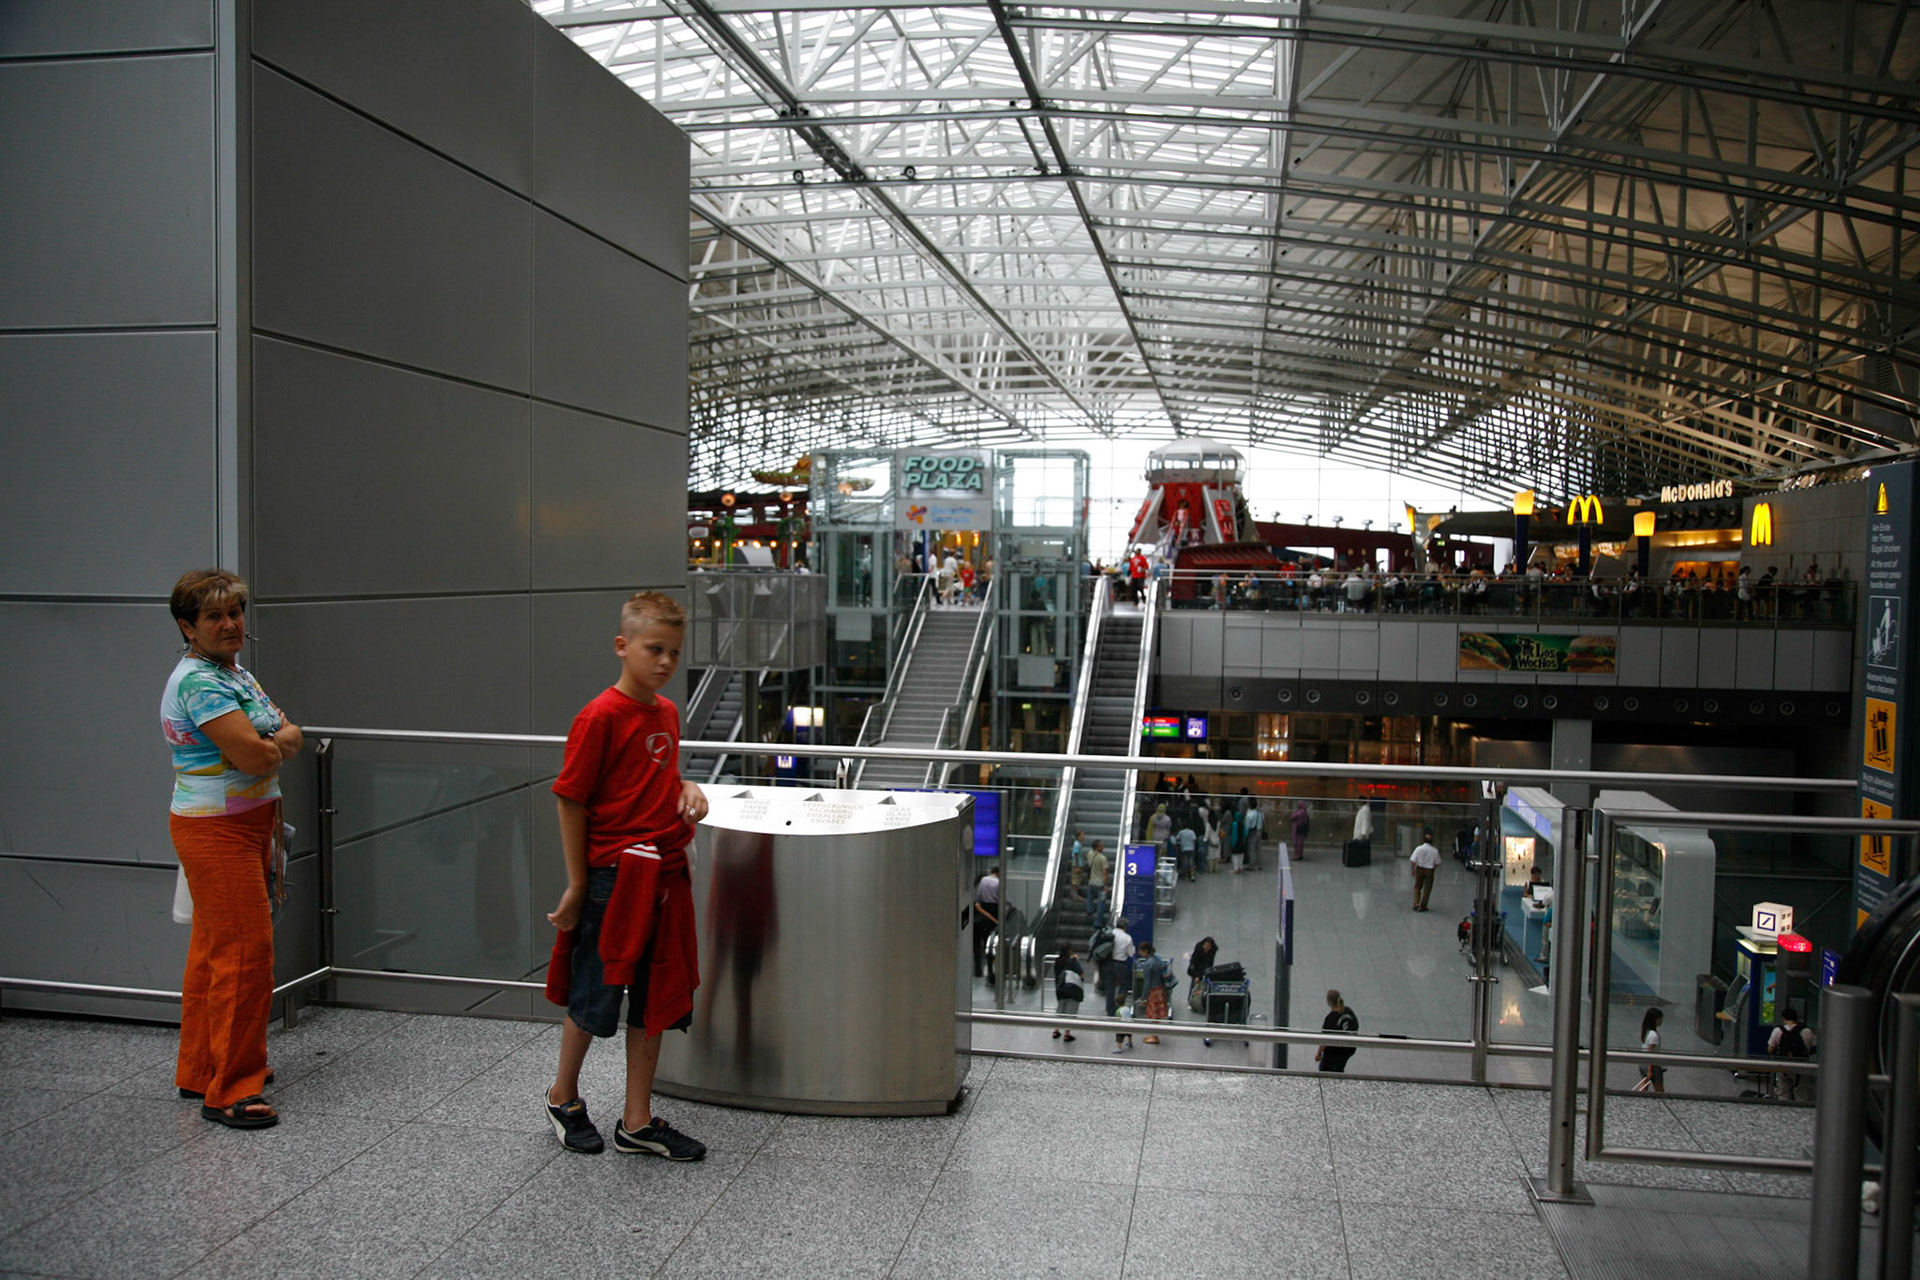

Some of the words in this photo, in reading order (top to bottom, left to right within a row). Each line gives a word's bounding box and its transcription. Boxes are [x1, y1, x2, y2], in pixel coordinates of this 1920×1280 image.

[904, 456, 984, 473] FOOD-
[903, 473, 982, 489] PLAZA
[1661, 479, 1733, 503] McDonald's
[1127, 862, 1137, 876] 3
